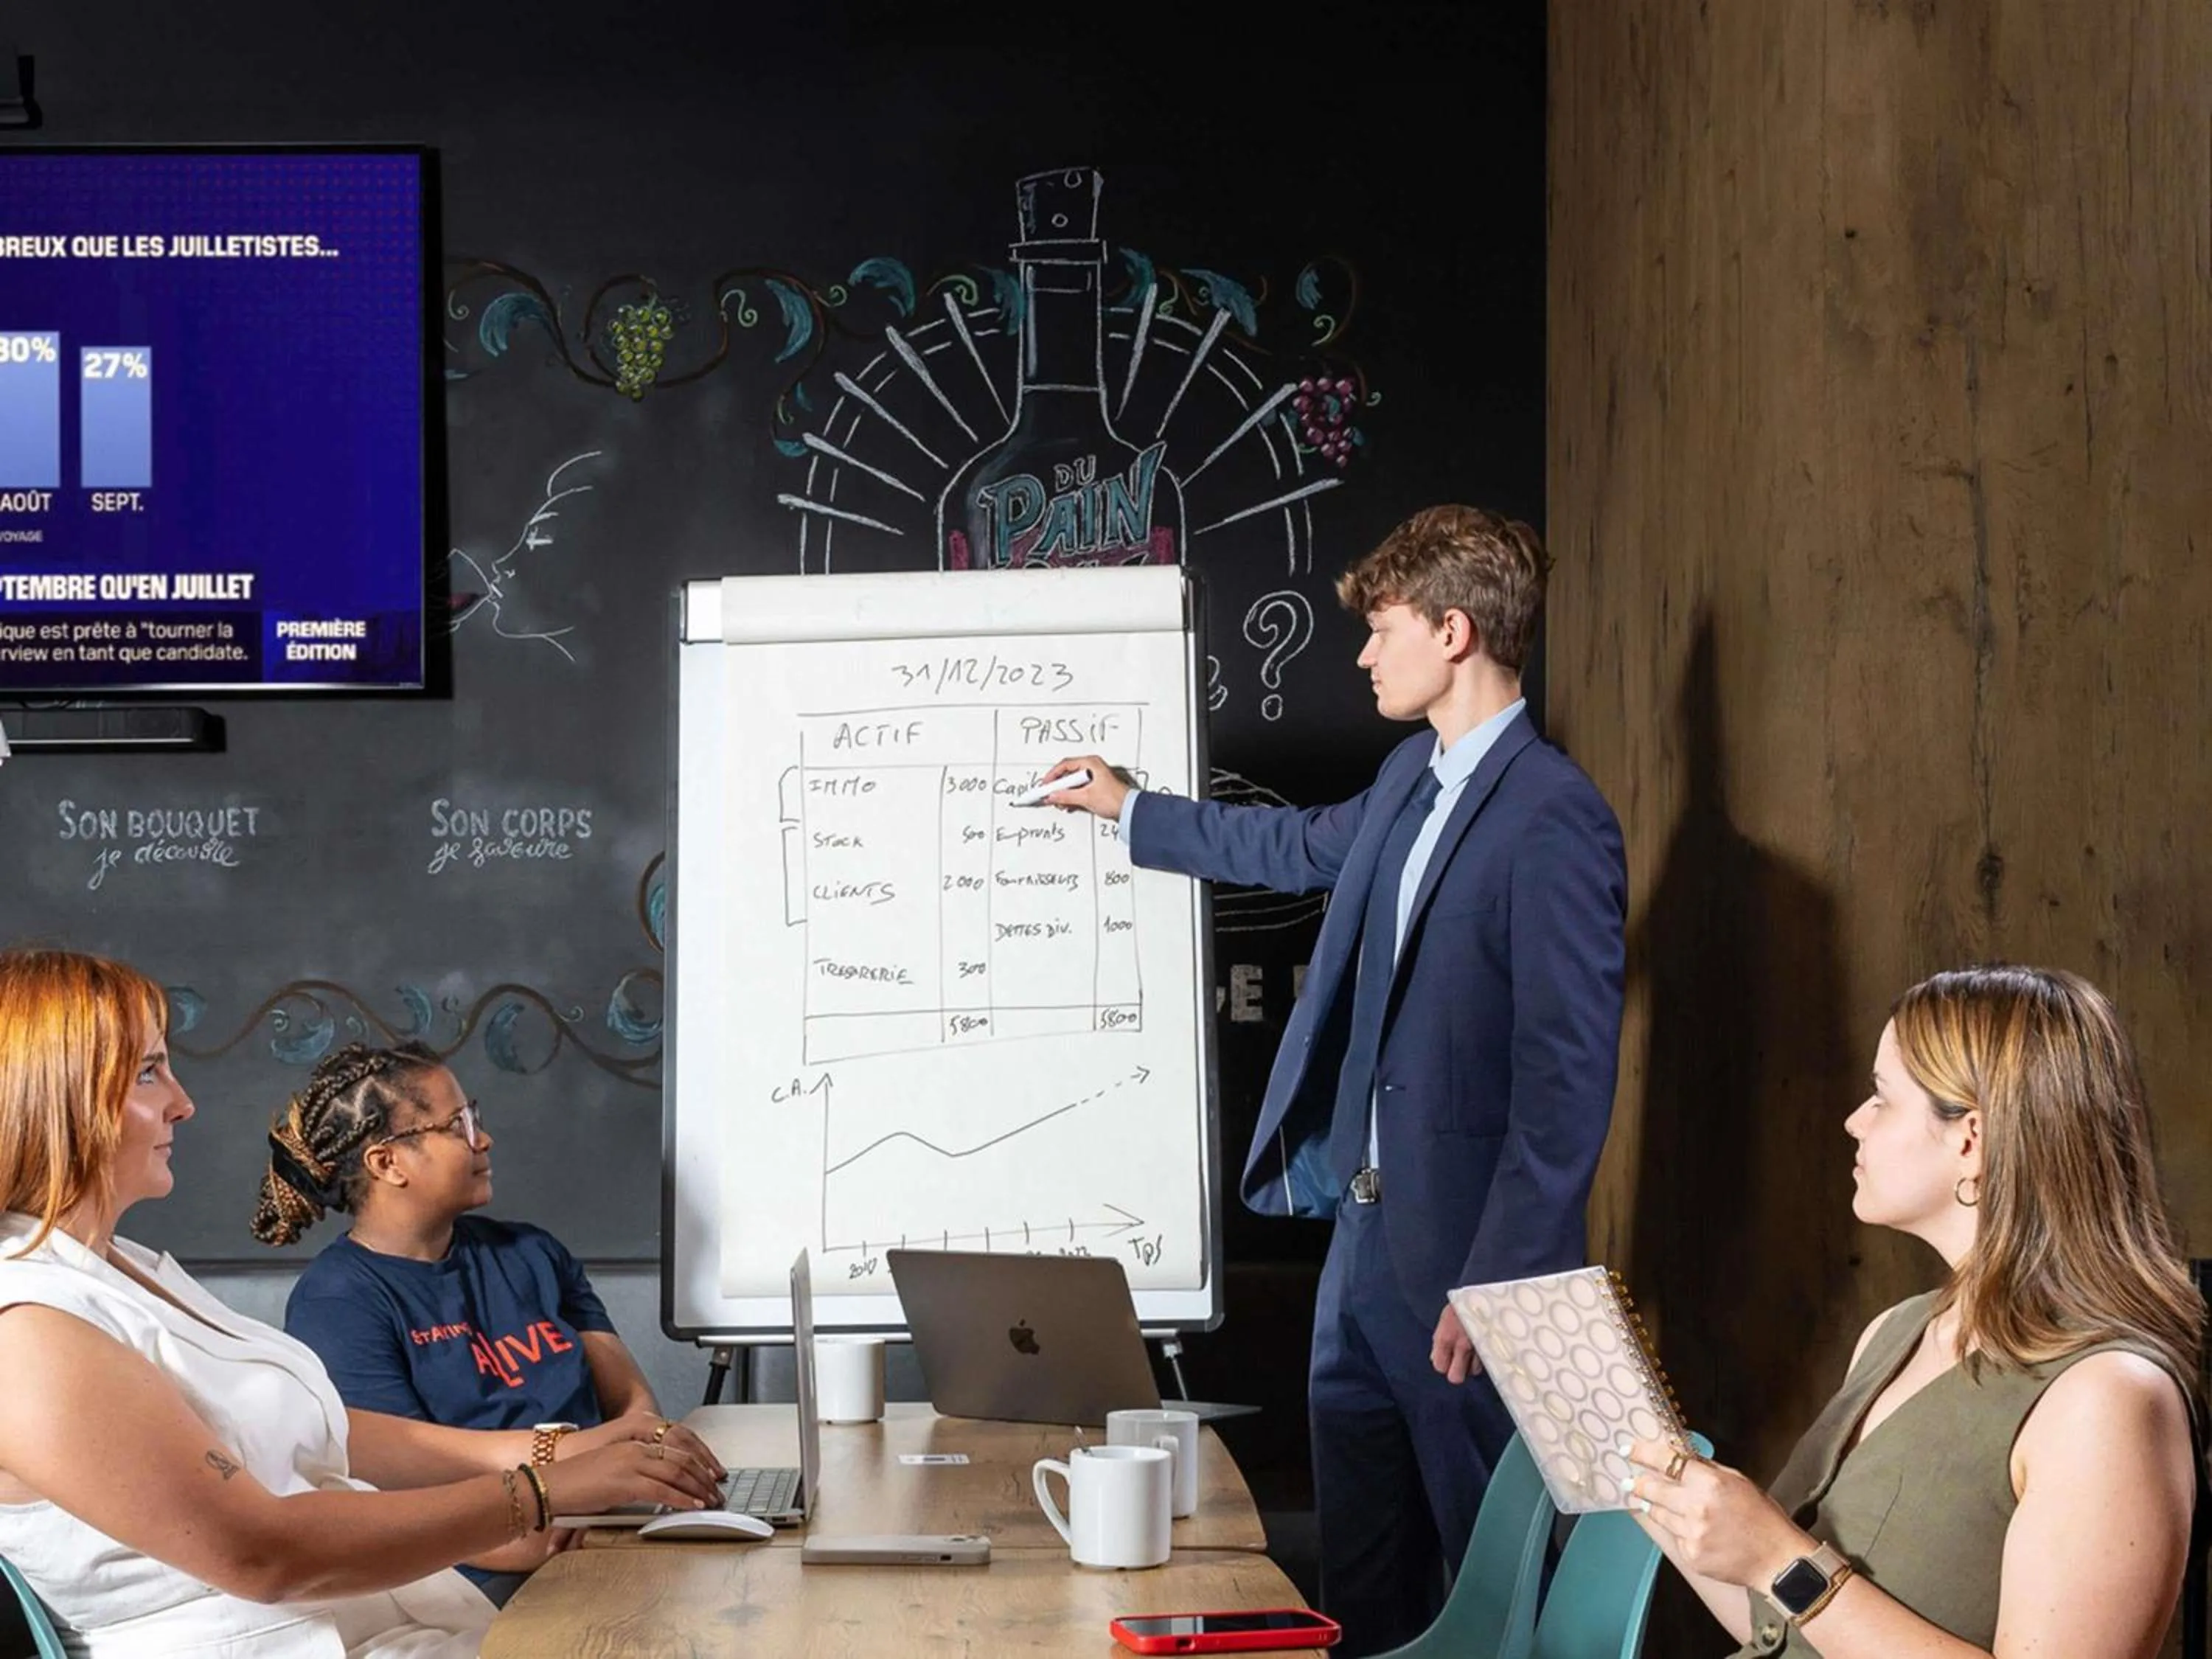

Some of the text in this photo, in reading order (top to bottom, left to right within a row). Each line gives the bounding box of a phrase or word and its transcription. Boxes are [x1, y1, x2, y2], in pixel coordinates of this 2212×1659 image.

[72, 236, 118, 257] QUE
[123, 236, 164, 257] LES
[168, 235, 339, 257] JUILLETISTES...
[83, 352, 148, 378] 27%
[1053, 454, 1096, 492] DU
[0, 490, 52, 512] AOÛT
[91, 493, 145, 512] SEPT.
[976, 442, 1166, 569] PAIN
[0, 574, 254, 600] TEMBRE QU'EN JUILLET
[40, 622, 69, 639] est
[74, 622, 120, 642] prête
[126, 622, 137, 639] à
[141, 622, 212, 639] "tourner
[218, 622, 233, 639] la
[276, 618, 366, 638] PREMIÈRE
[52, 647, 74, 661] en
[79, 644, 115, 661] tant
[119, 647, 152, 664] que
[156, 644, 248, 661] candidate.
[286, 641, 357, 660] ÉDITION
[892, 655, 1074, 695] 31/12/2023
[833, 721, 924, 749] ACTIF
[128, 807, 260, 839] BOUQUET
[501, 808, 593, 838] CORPS
[1100, 823, 1119, 842] 24
[87, 847, 122, 890] je
[959, 961, 987, 978] 300
[471, 1321, 574, 1387] ALIVE
